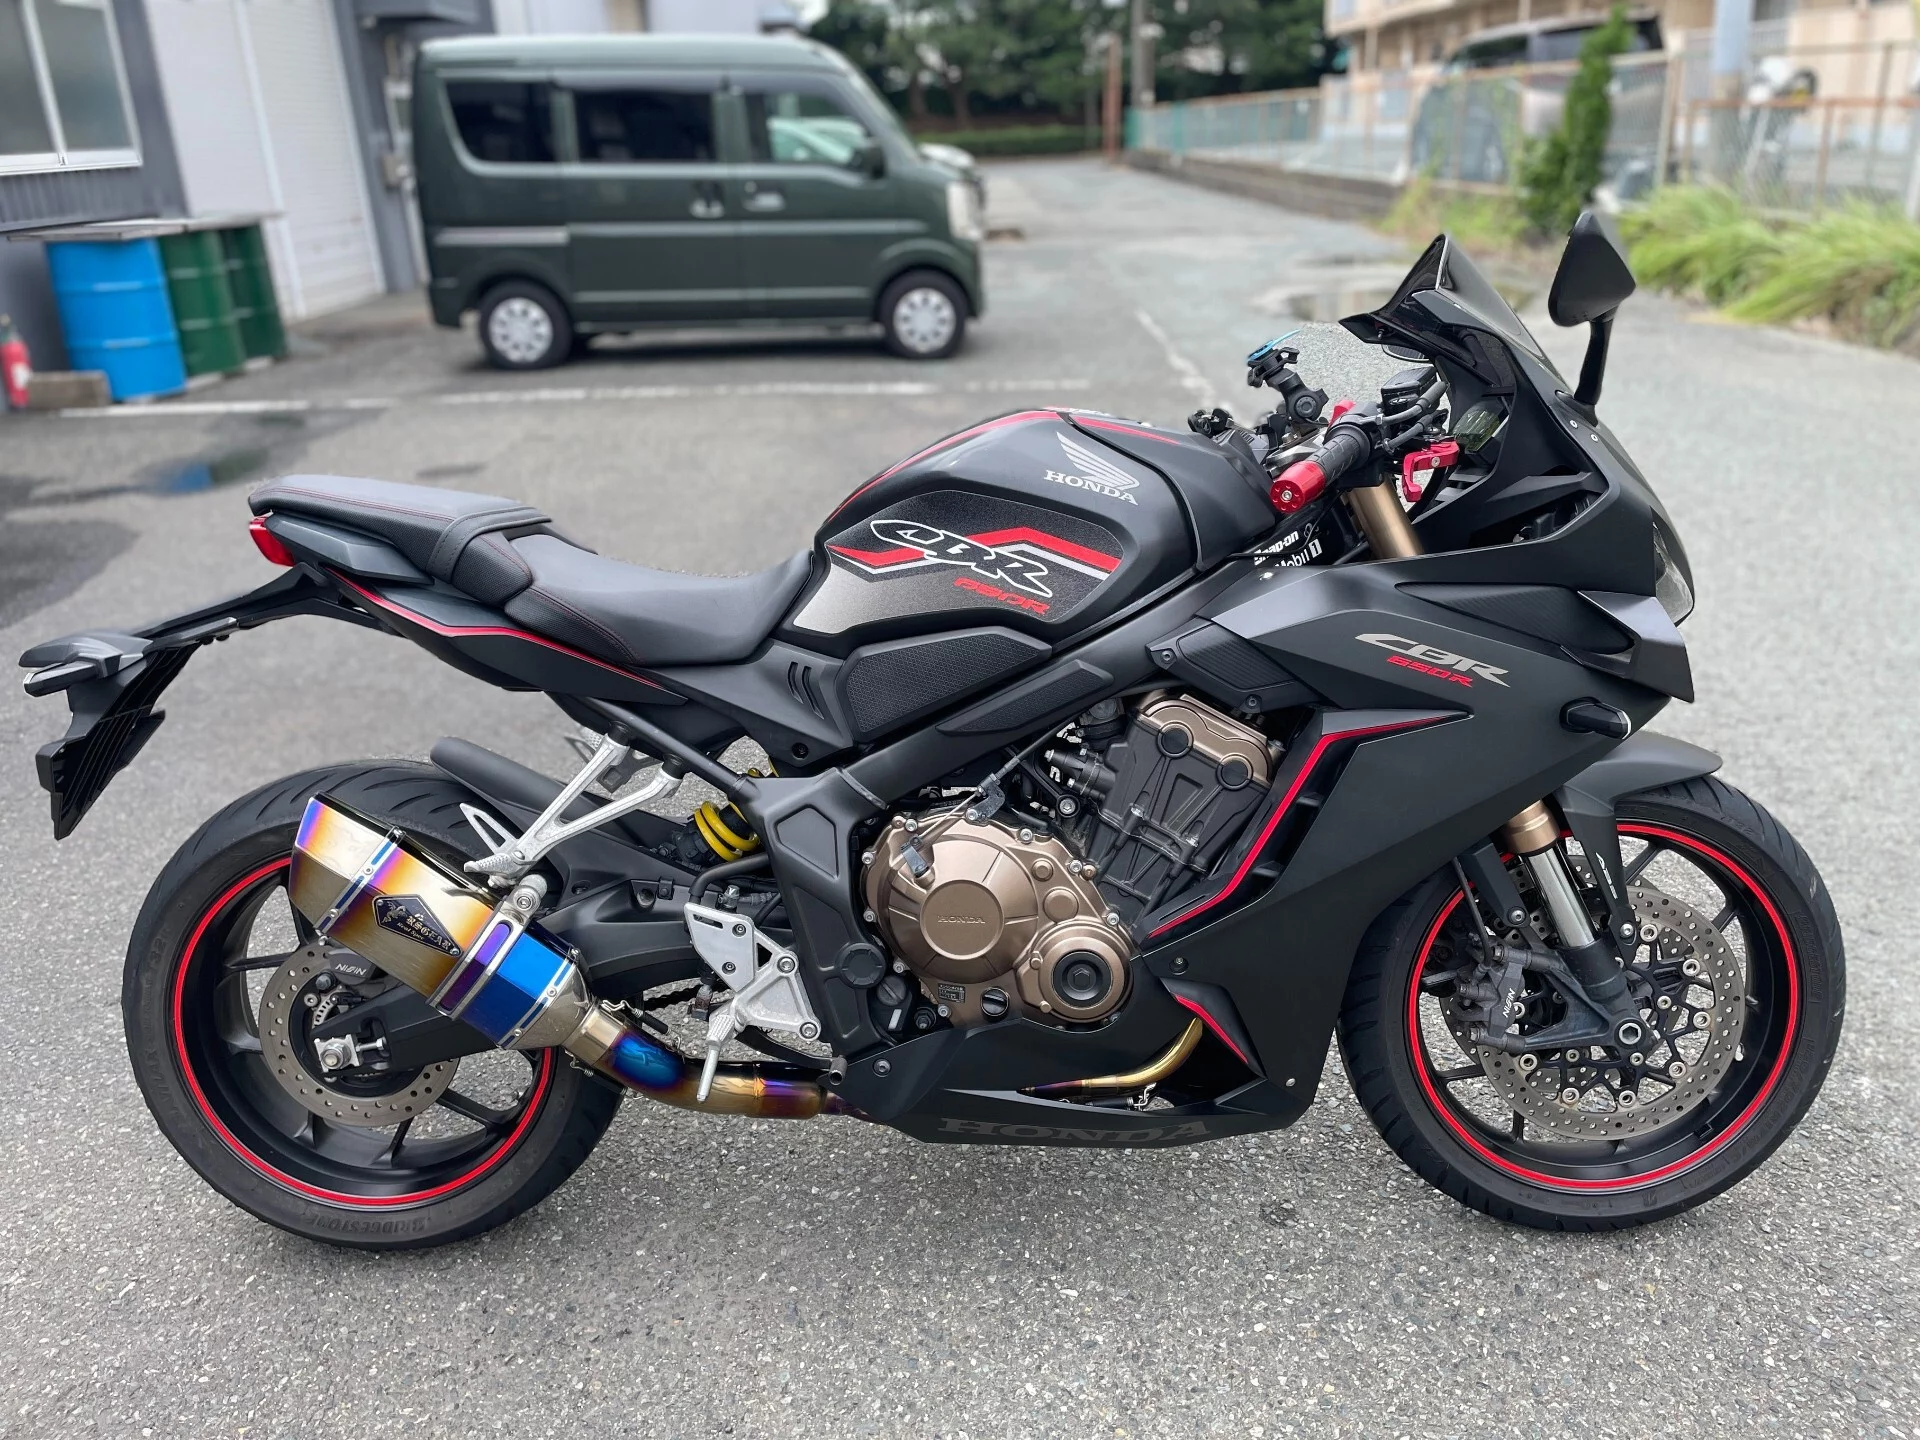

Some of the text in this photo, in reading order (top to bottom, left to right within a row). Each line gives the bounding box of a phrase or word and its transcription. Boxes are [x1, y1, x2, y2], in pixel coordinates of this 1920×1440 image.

[1044, 470, 1138, 505] HONDA
[870, 520, 1052, 597] CBR
[1355, 634, 1511, 687] CBR
[1387, 655, 1473, 688] 650R
[937, 915, 986, 924] HONDA
[938, 1118, 1210, 1142] HONDA
